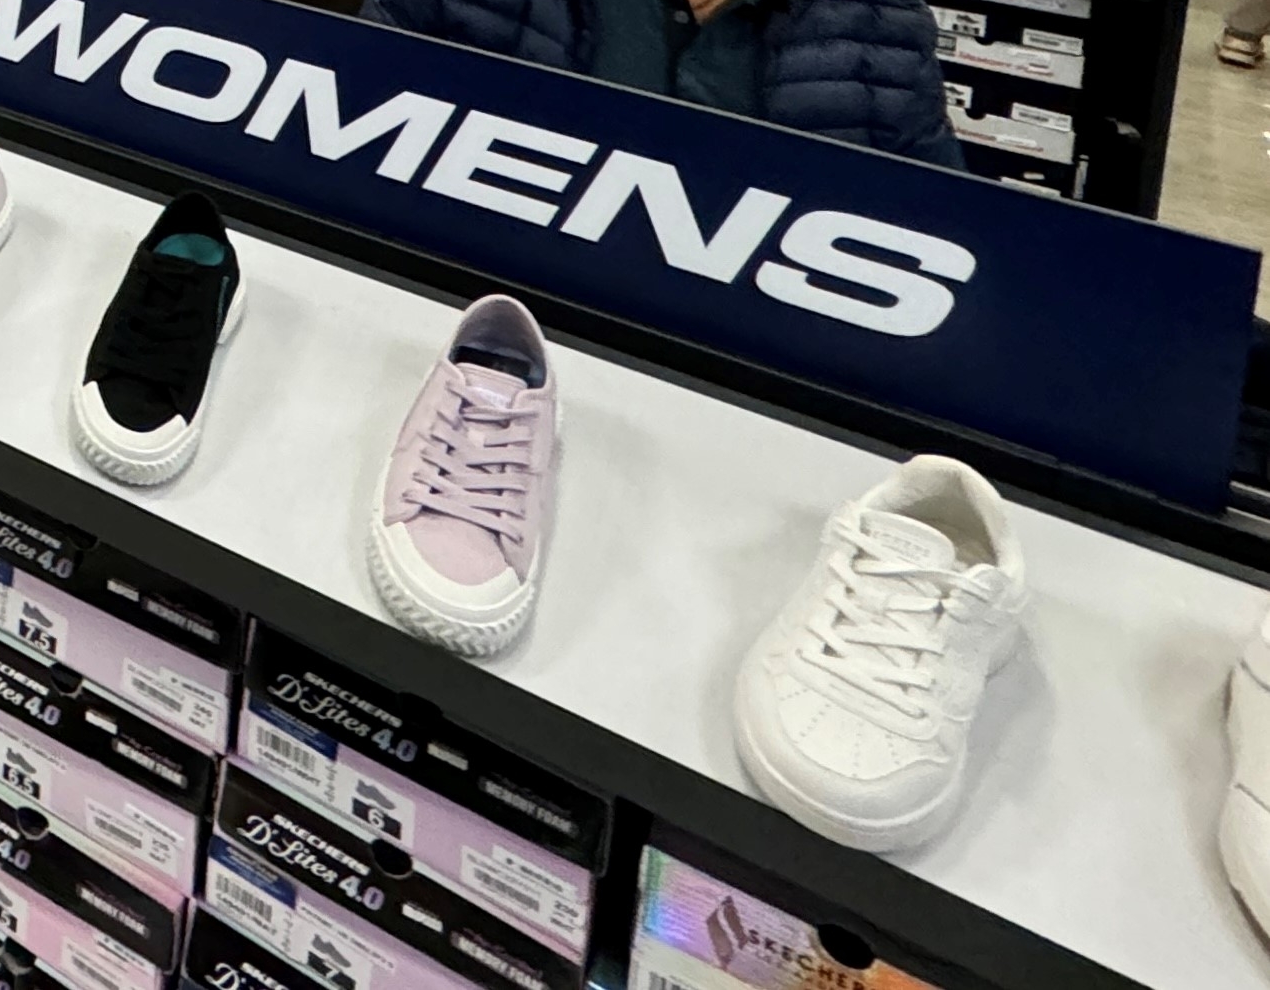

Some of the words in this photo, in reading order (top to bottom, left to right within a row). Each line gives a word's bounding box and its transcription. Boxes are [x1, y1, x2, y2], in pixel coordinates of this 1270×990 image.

[24, 623, 52, 652] 7.5
[267, 673, 369, 739] D'Lites
[303, 670, 403, 728] SKECHERS
[237, 815, 339, 884] D'Lites
[273, 814, 371, 876] SKECHERS
[367, 808, 385, 830] 6
[747, 928, 867, 990] SKECHER
